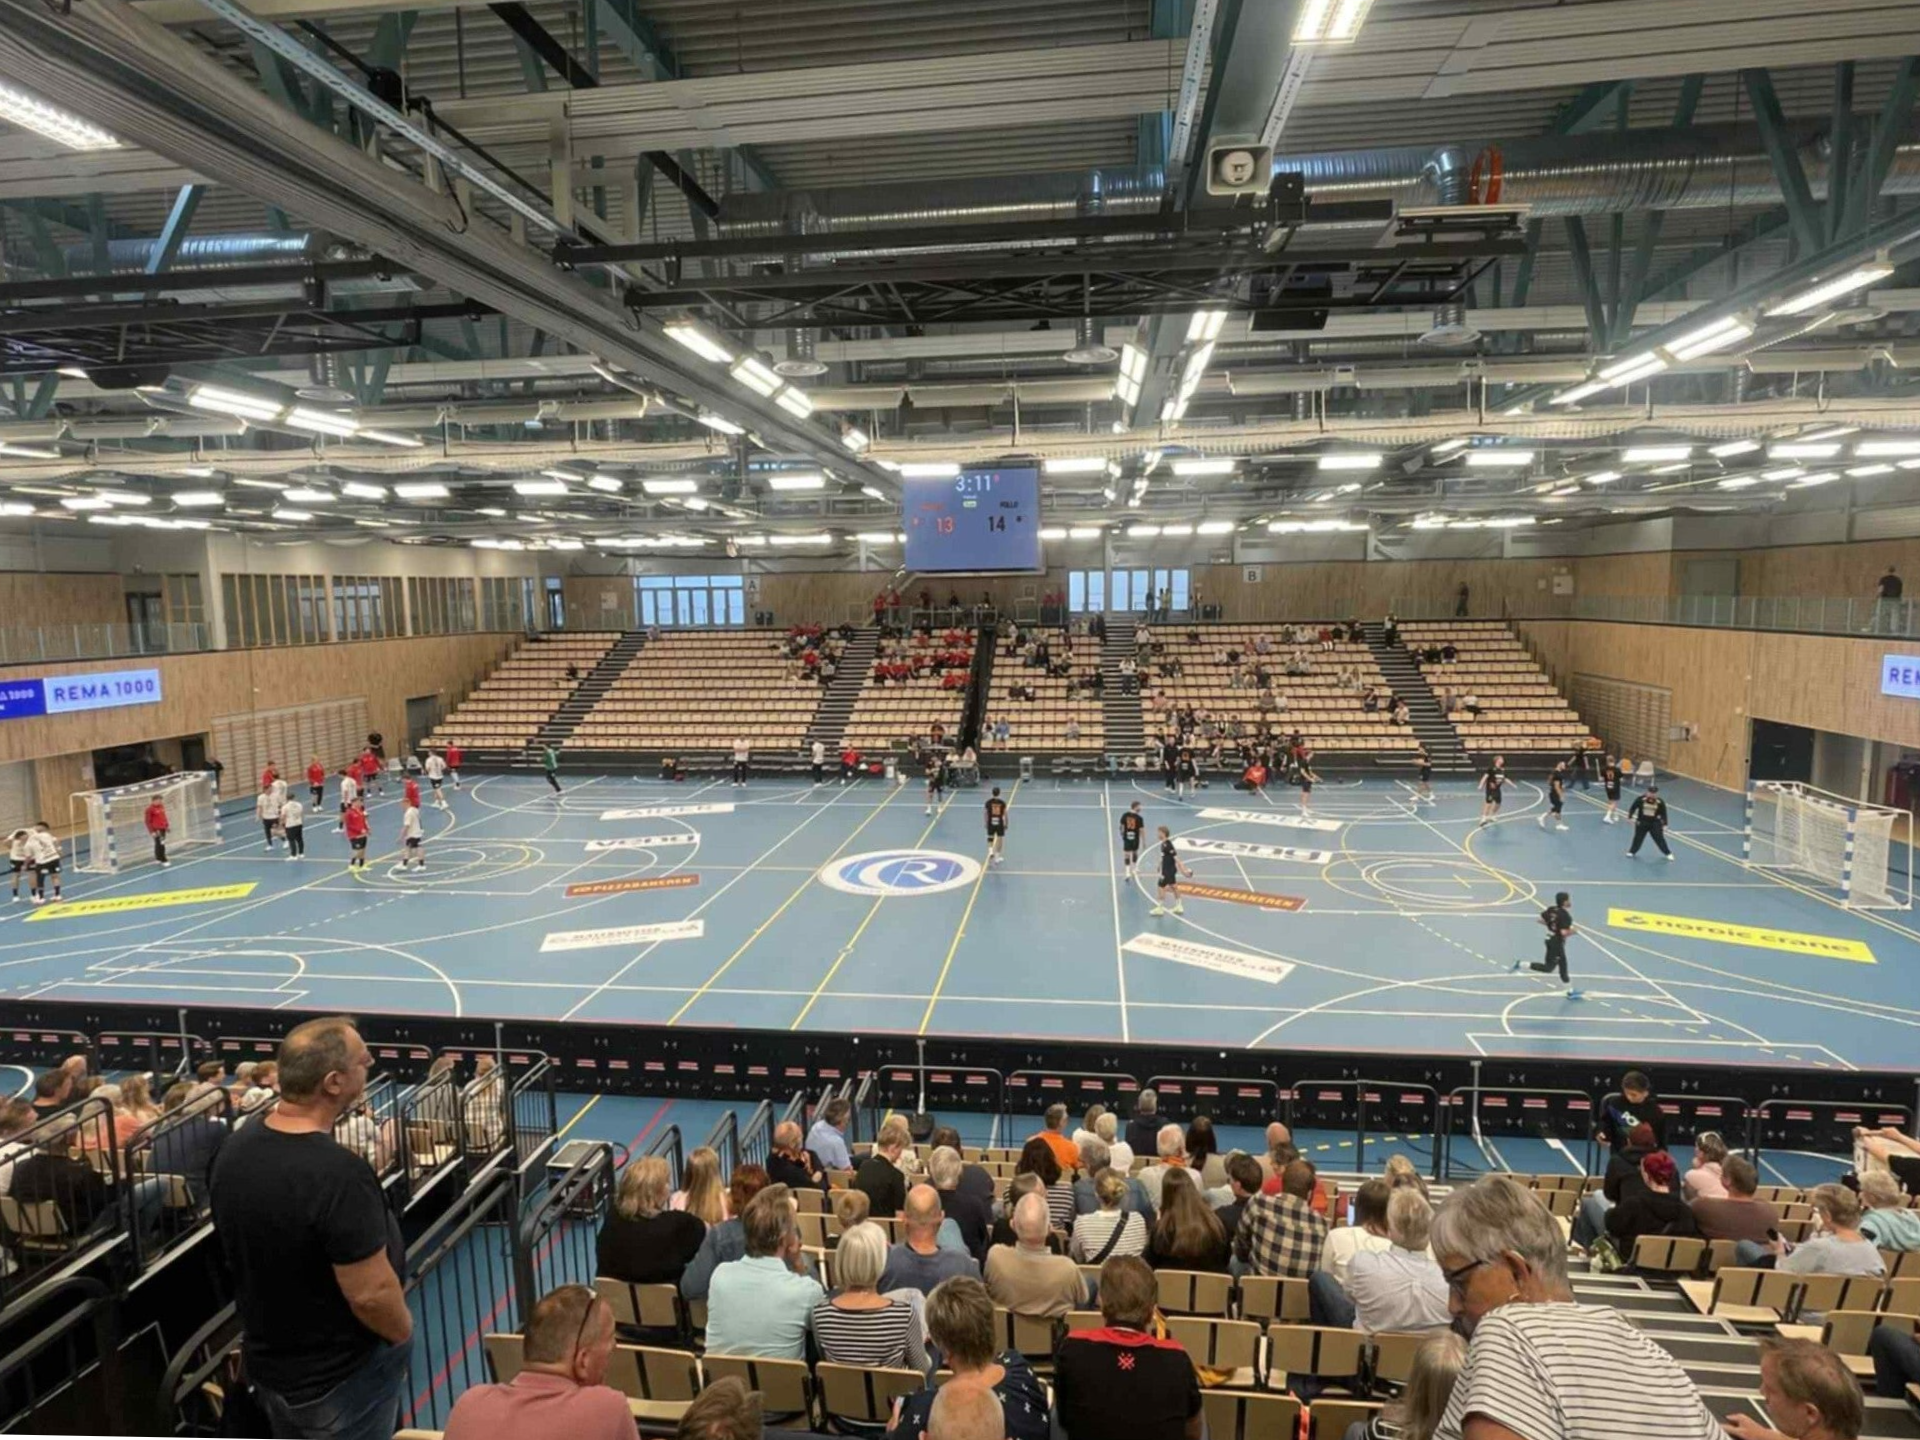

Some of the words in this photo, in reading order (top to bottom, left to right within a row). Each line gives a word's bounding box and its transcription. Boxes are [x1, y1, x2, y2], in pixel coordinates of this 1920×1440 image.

[956, 475, 991, 491] 3:11
[937, 517, 954, 534] 13
[988, 516, 1006, 532] 14
[1248, 571, 1256, 581] B
[54, 683, 110, 702] REMA
[115, 679, 155, 696] 1000
[593, 877, 693, 892] PIZZABAKEREN
[1193, 886, 1295, 908] PIZZABAKEREN
[1761, 933, 1850, 953] crane
